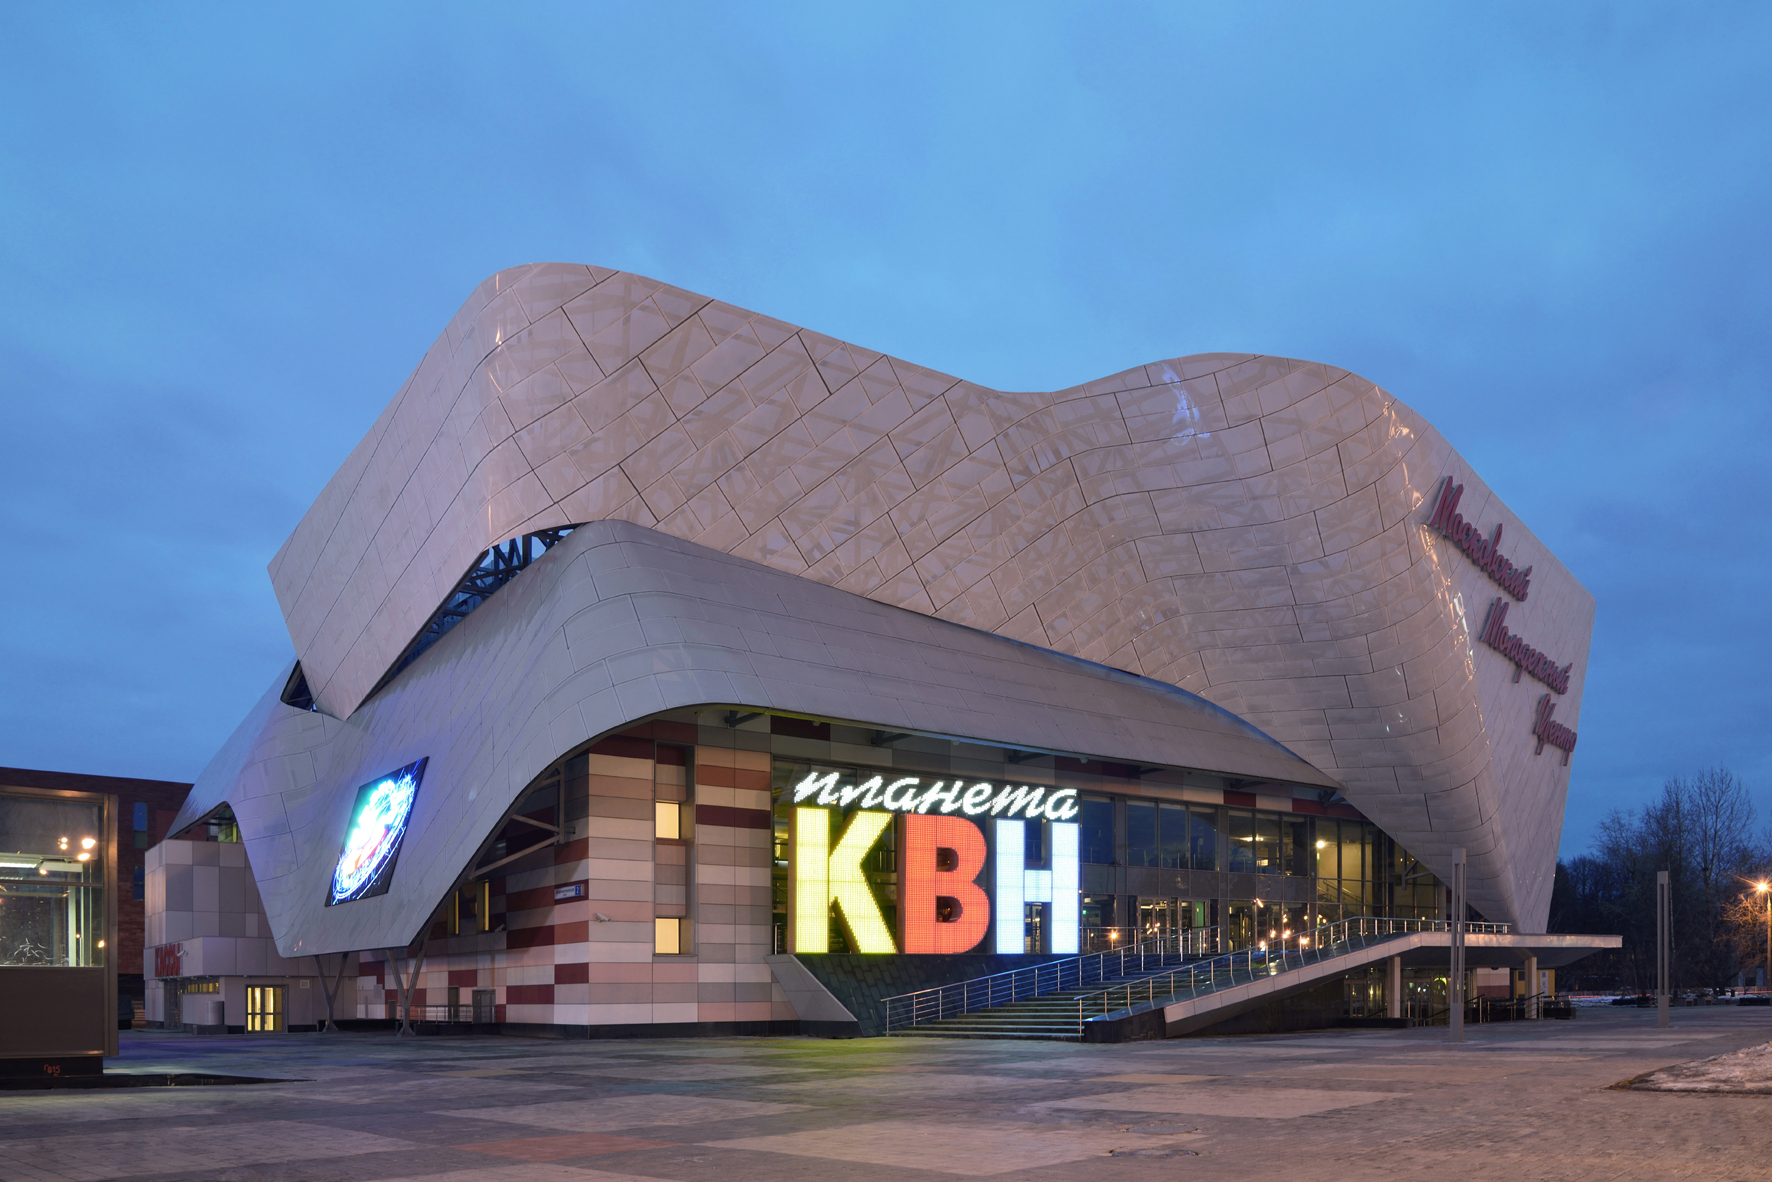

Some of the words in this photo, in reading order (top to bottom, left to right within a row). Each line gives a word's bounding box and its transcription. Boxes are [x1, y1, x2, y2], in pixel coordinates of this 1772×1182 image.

[1429, 475, 1532, 602] Московский
[1480, 597, 1573, 695] Молодежный
[1534, 693, 1578, 766] Центр
[793, 771, 1080, 820] планета
[789, 807, 1080, 955] КВН
[154, 942, 181, 978] КАССЫ
